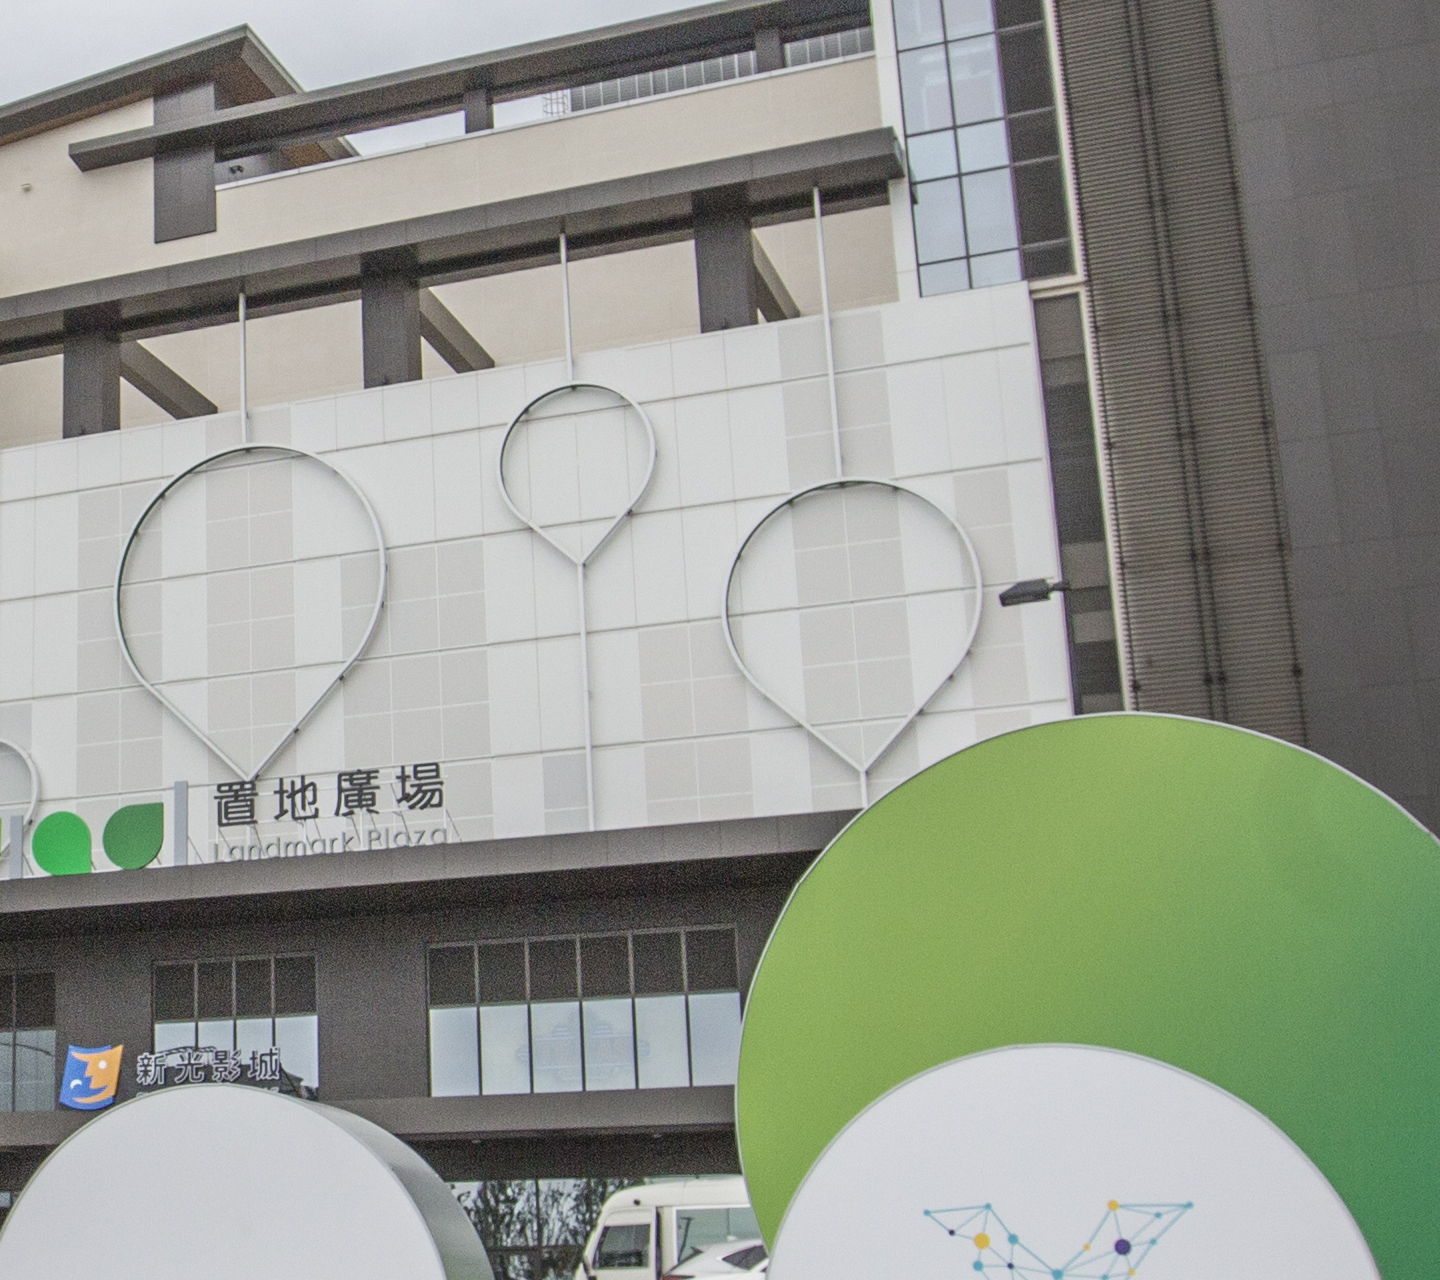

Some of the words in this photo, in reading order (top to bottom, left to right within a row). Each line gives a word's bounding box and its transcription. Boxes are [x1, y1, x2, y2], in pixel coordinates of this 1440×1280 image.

[213, 762, 445, 828] 置地廣場
[136, 1047, 282, 1086] 新光影城
